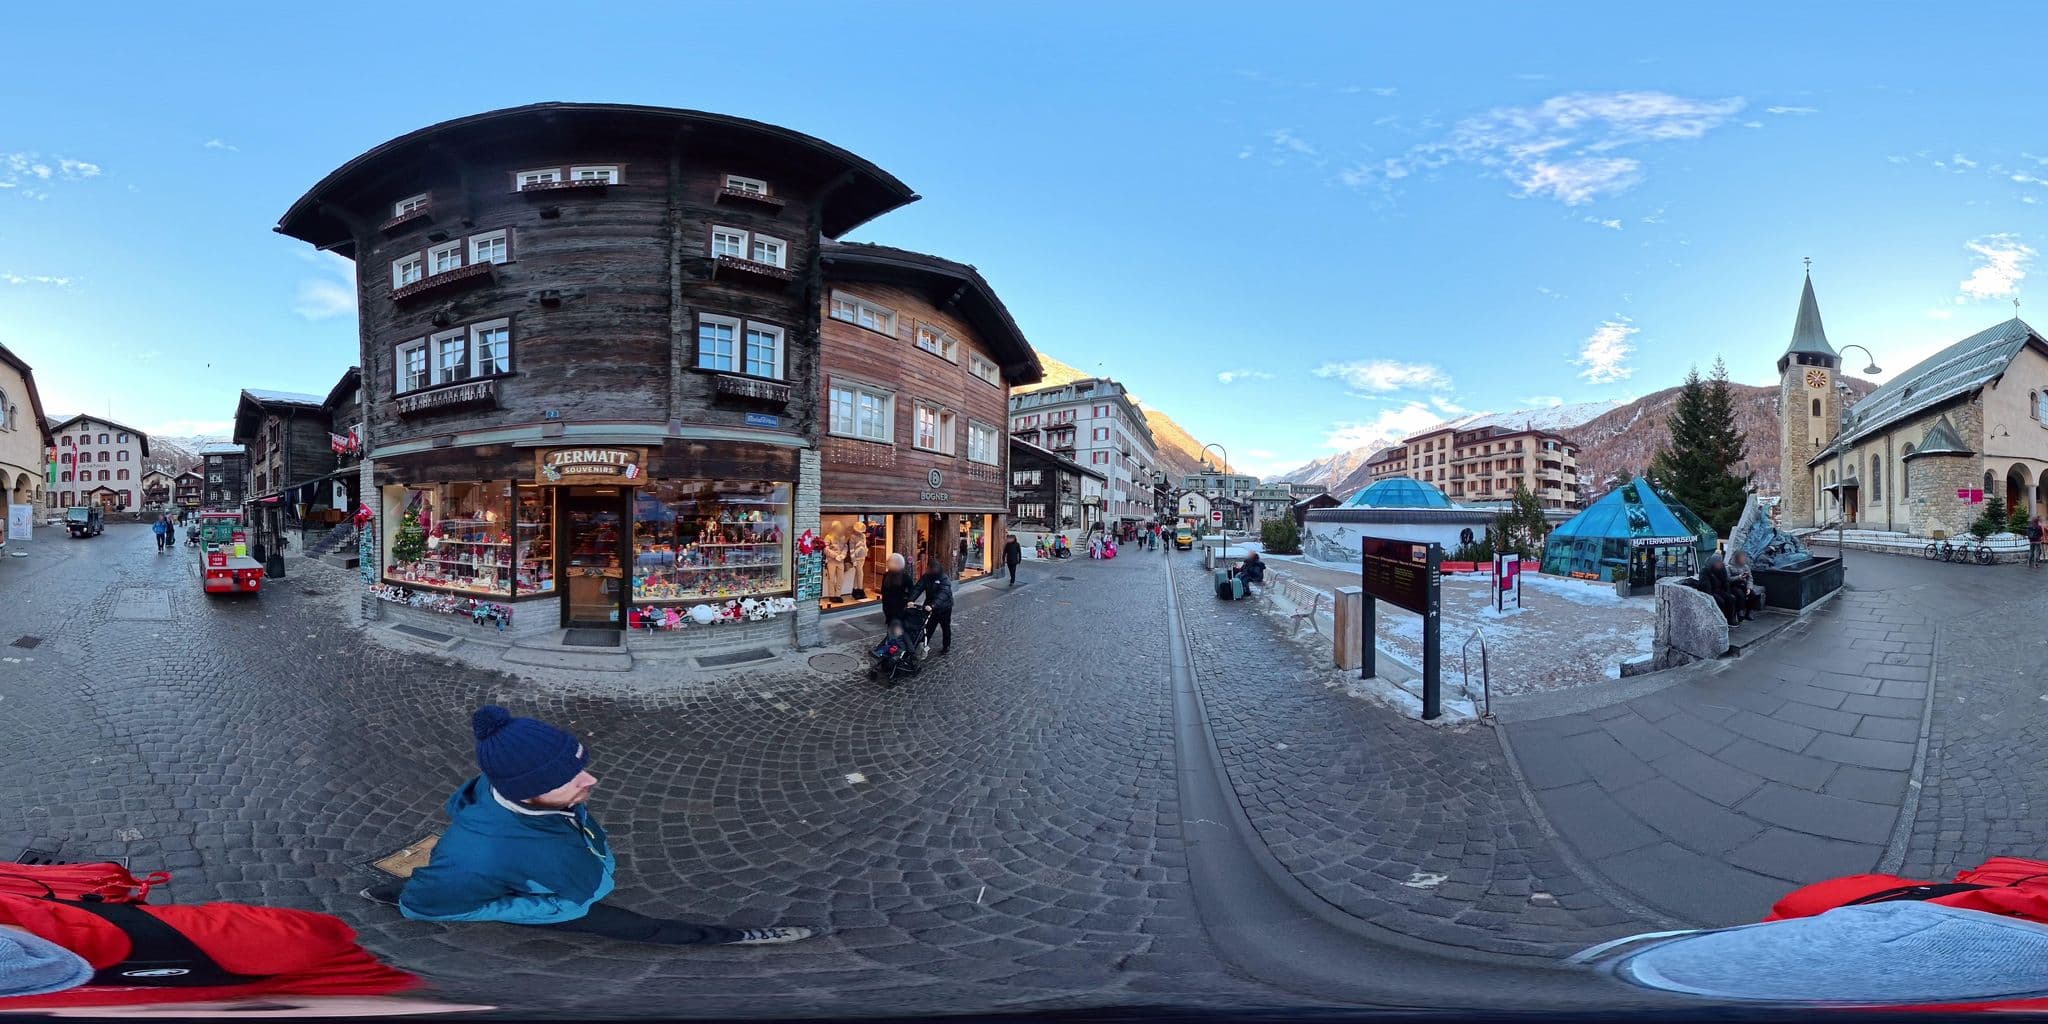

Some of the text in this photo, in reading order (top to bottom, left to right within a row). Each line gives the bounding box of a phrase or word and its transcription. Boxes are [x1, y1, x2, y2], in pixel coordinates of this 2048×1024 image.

[554, 450, 628, 465] ZERMATT
[565, 466, 614, 474] SOUVENIRS
[920, 492, 949, 502] BOGNER
[1632, 535, 1698, 546] MATTERHORN MUSEUM
